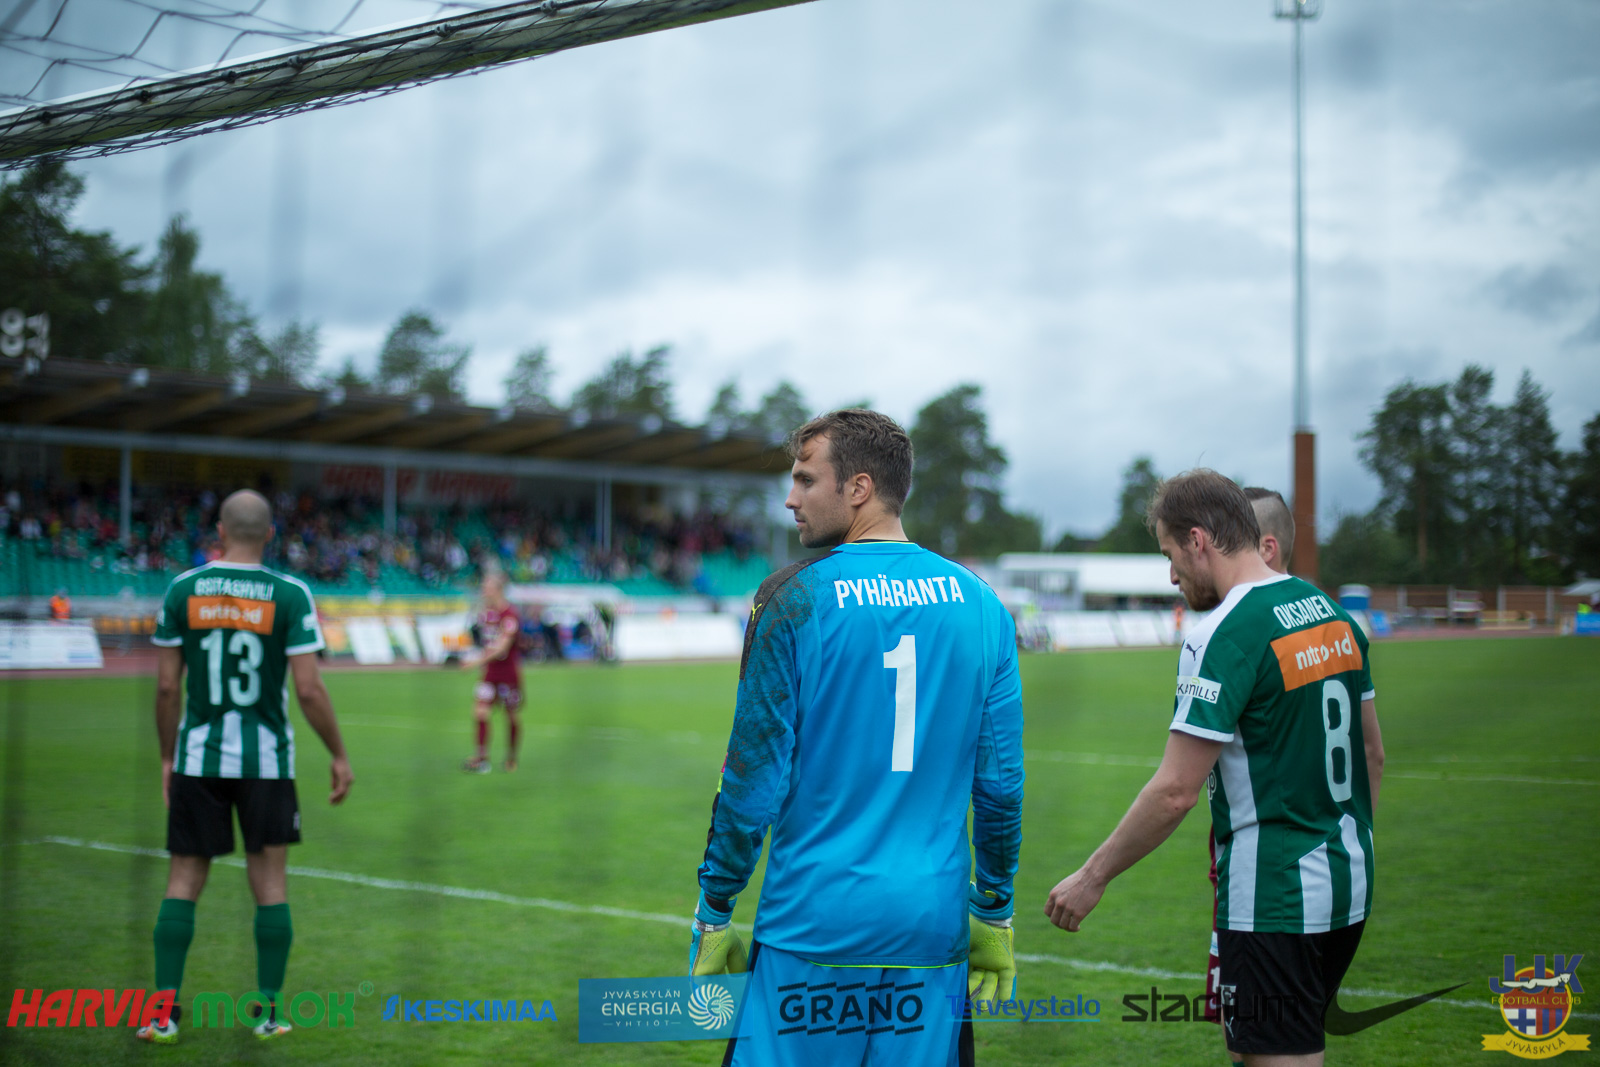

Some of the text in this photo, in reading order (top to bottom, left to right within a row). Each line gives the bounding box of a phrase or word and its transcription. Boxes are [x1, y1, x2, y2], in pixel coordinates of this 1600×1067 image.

[834, 573, 965, 608] PYHÄRANTA
[1273, 594, 1337, 630] OKSANEN
[200, 628, 264, 707] 13
[883, 634, 917, 772] 1
[1322, 679, 1353, 803] 8
